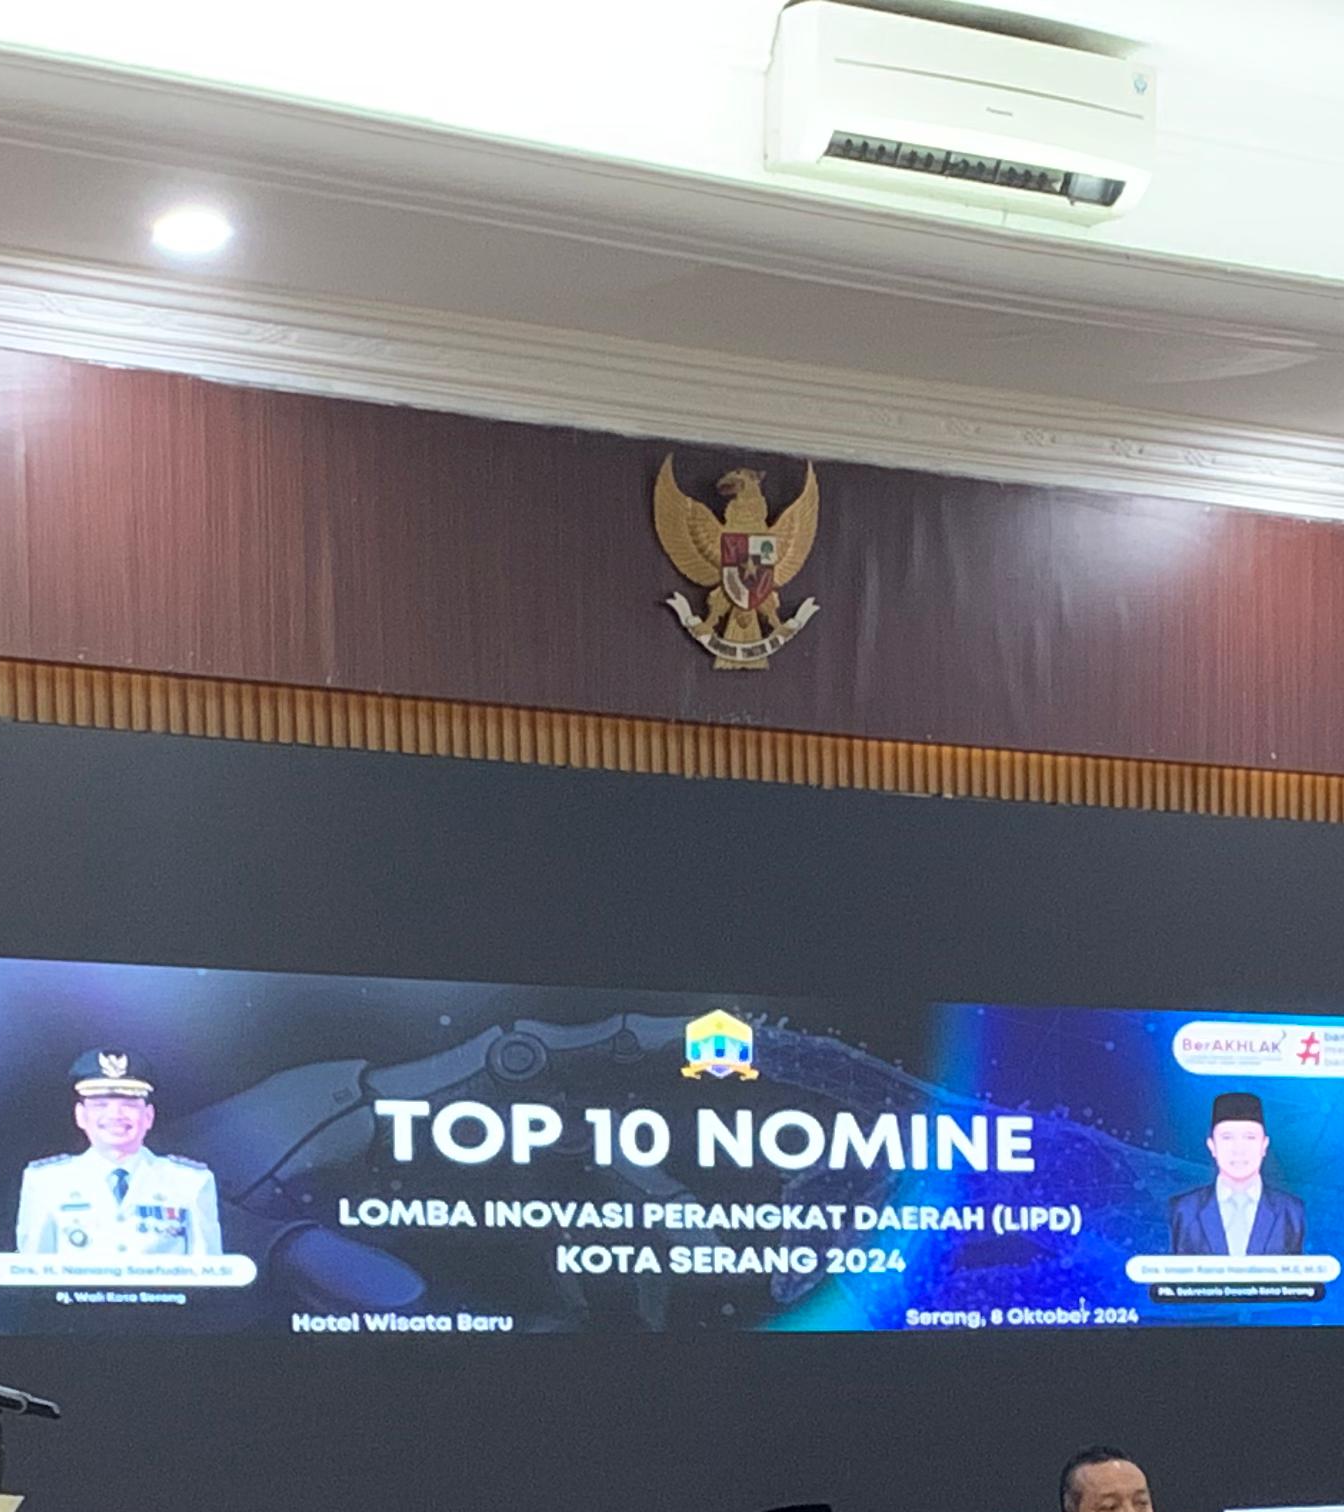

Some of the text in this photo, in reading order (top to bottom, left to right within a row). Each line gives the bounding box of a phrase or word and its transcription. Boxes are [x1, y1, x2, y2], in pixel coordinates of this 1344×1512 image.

[1182, 1037, 1281, 1053] BerAKHLAK
[375, 1099, 1036, 1172] TOP 10 NOMINE
[339, 1198, 1083, 1235] LOMBA INOVASI PERANGKAT DAERAH (LIPD)
[557, 1245, 907, 1274] KOTA SERANG 2024
[292, 1312, 513, 1332] Hotel Wisata Baru
[906, 1307, 1139, 1328] Serang, 8 Oktober 2024
